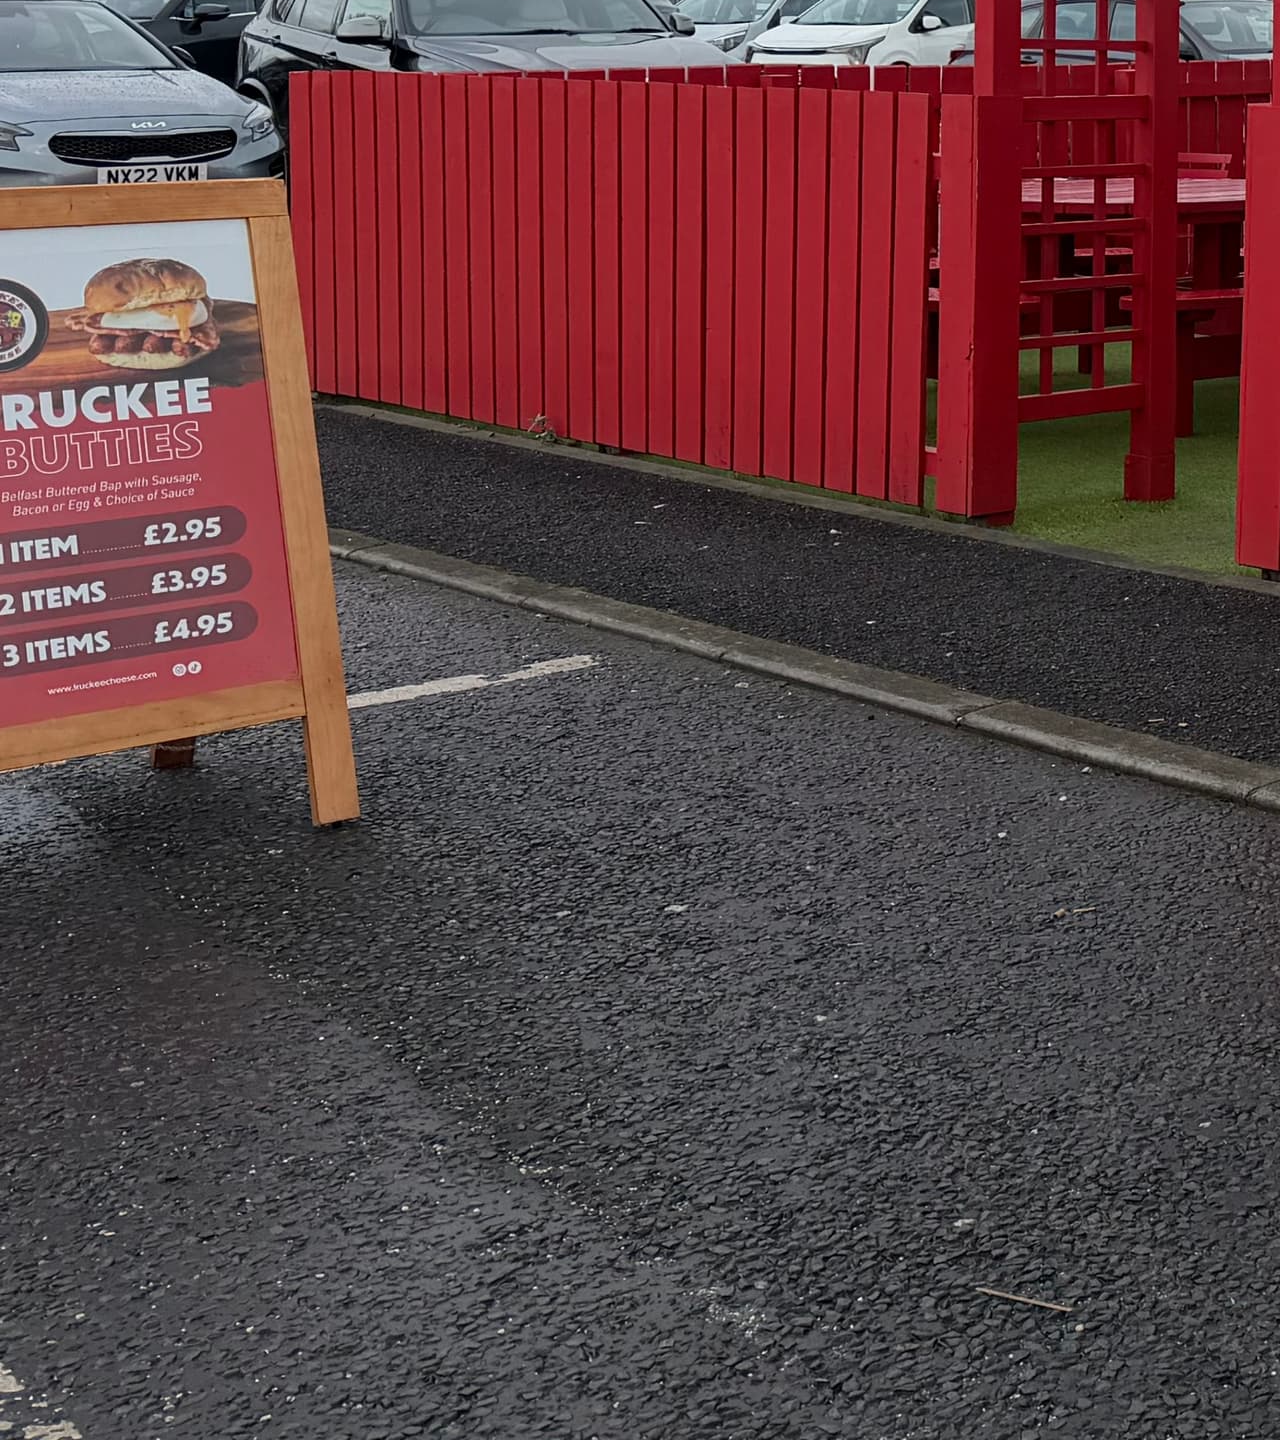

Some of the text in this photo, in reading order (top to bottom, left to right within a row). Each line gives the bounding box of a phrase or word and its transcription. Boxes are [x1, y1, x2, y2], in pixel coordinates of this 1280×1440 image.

[107, 165, 199, 184] NX22 VKM
[0, 420, 203, 479] BUTTIES
[1, 487, 42, 503] Belfast
[46, 482, 96, 498] Buttered
[100, 480, 122, 493] Bap
[125, 476, 148, 489] with
[13, 487, 195, 517] Bacon or Egg & Choice of Sauce
[10, 535, 79, 563] ITEM
[144, 516, 222, 546] £2.95
[0, 564, 227, 616] 2 ITEMS £3.95
[3, 612, 233, 667] 3 ITEMS £4.95
[47, 671, 157, 695] www.truckeecheese.com
